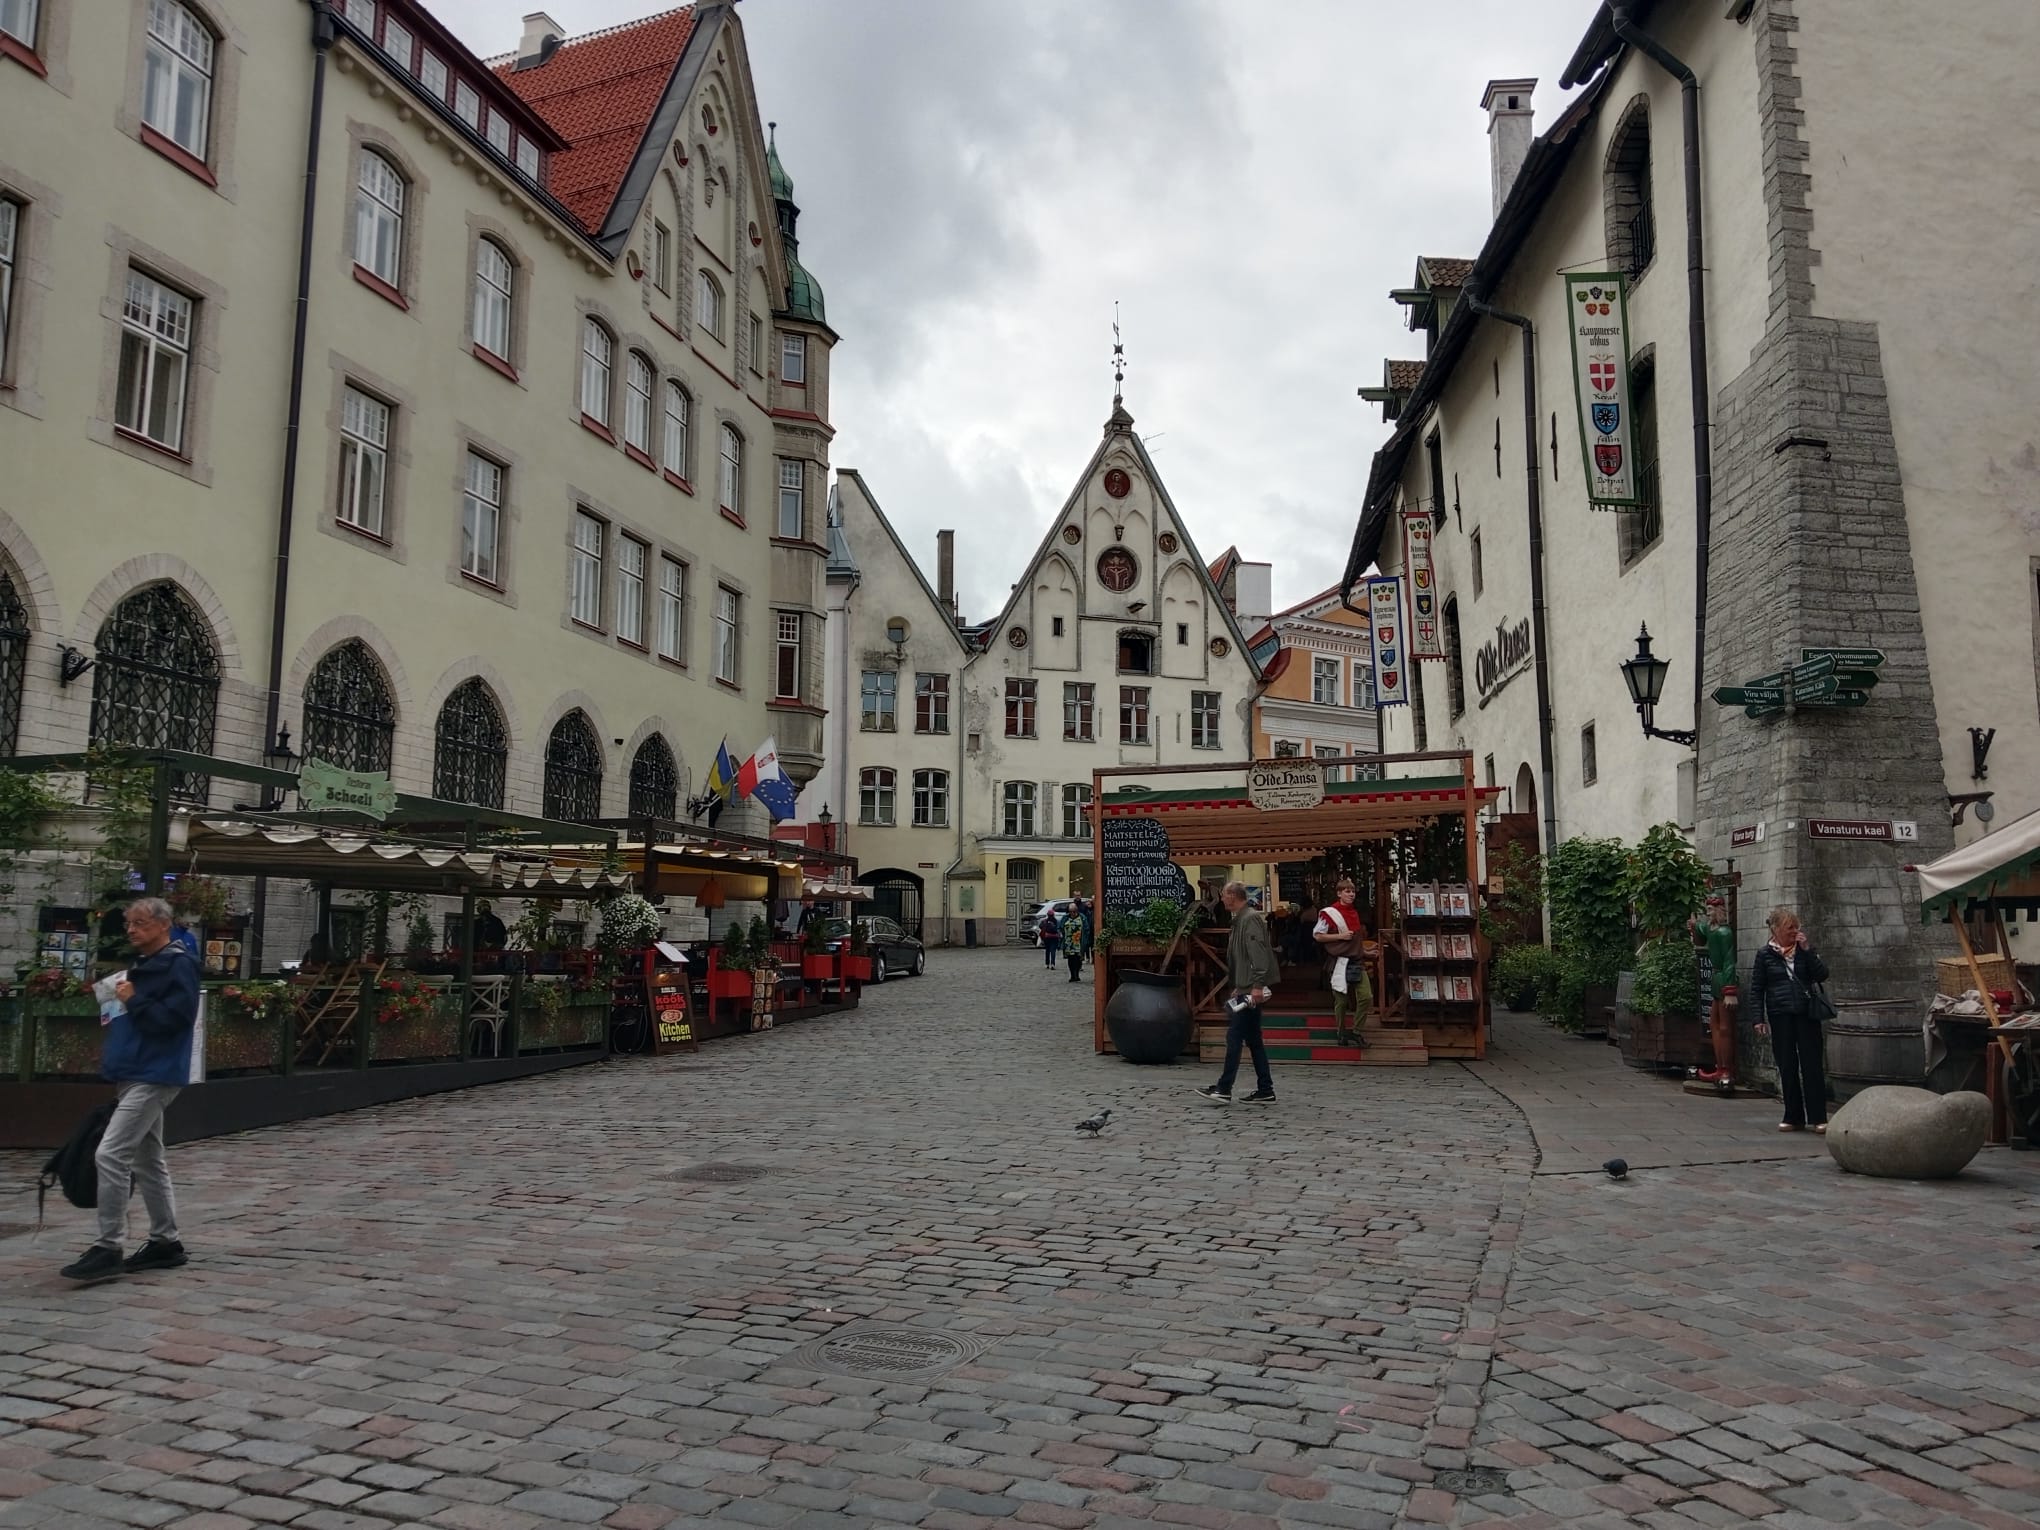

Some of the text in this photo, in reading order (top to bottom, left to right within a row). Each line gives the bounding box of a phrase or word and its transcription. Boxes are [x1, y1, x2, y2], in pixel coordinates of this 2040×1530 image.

[1744, 690, 1779, 699] Viru väljak
[1253, 770, 1317, 787] Olde Hansa
[1816, 823, 1912, 837] Vanaturu kael 12
[1105, 888, 1177, 898] ARTISAN DRINKS
[1106, 895, 1136, 905] LOCAL
[659, 1022, 691, 1037] Kitchen
[671, 1034, 692, 1042] open
